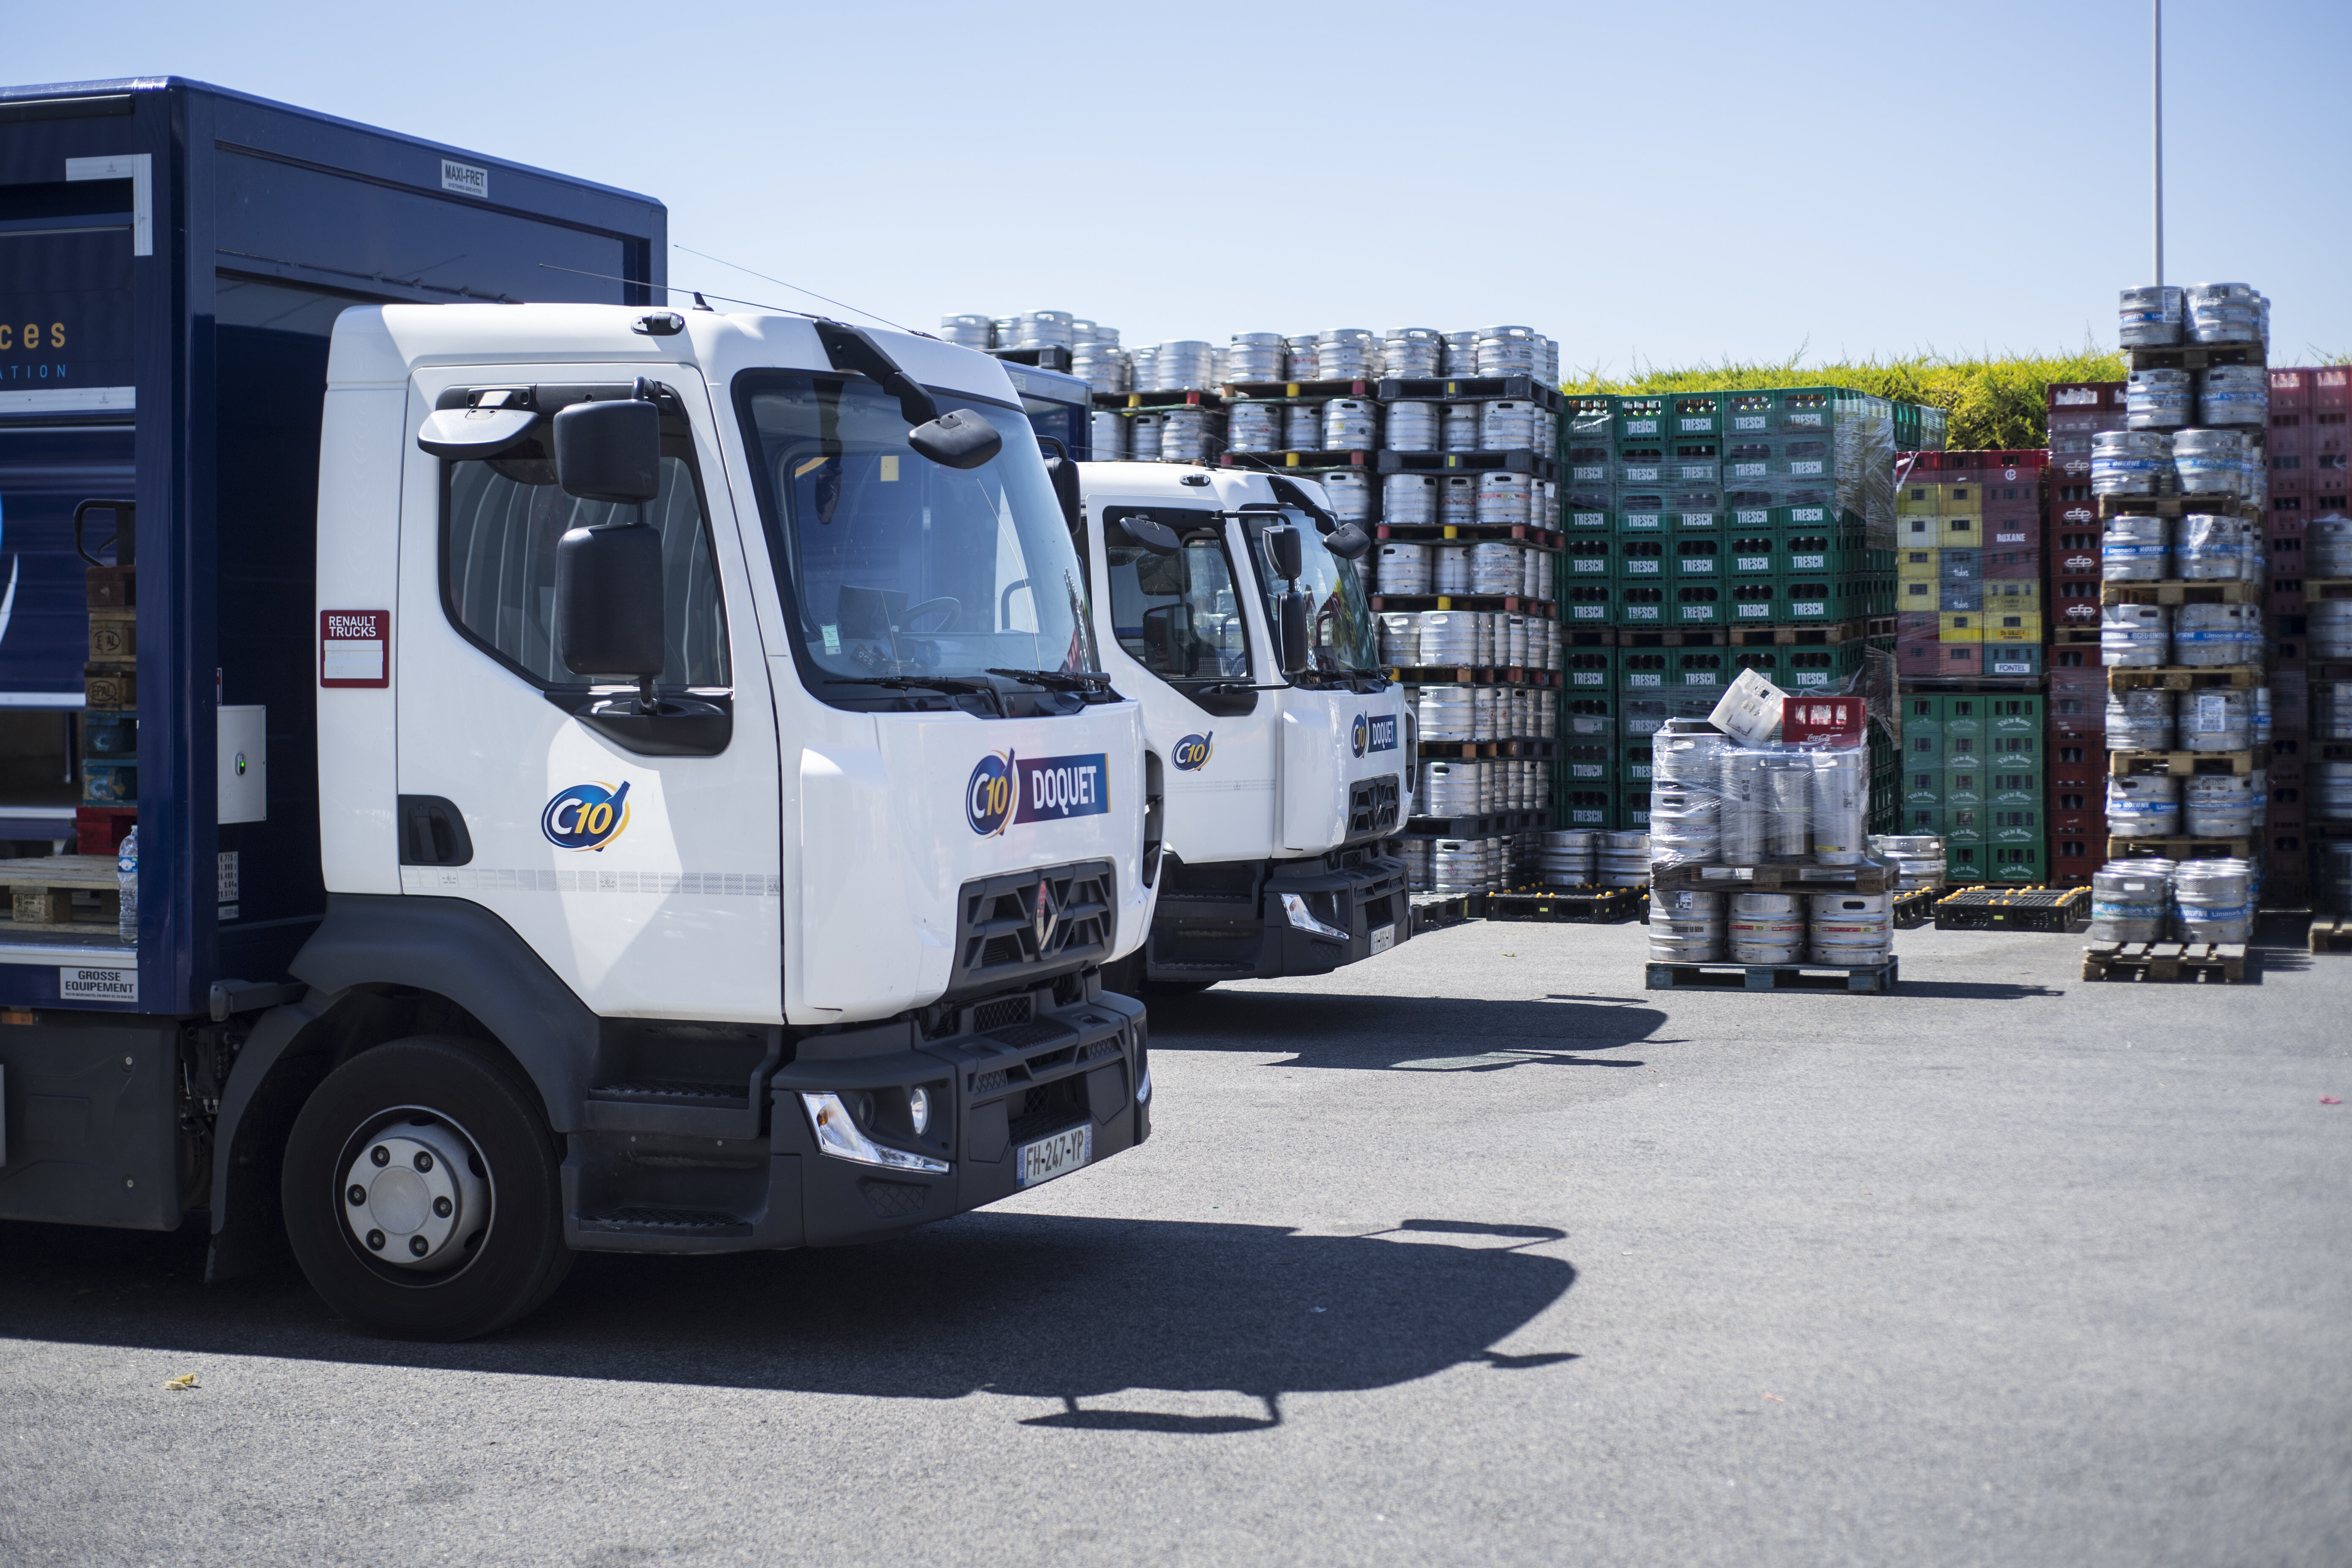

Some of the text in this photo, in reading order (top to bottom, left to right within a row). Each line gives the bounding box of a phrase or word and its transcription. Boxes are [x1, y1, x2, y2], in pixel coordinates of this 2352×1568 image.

[1681, 418, 1711, 430] TRESCH
[1735, 416, 1765, 429] TRESCH
[1735, 463, 1766, 476] TRESCH
[1791, 461, 1822, 474] TRESCH
[2066, 460, 2089, 471] cfp
[1573, 467, 1603, 479] TRESCH
[1627, 468, 1657, 480] TRESCH
[1574, 513, 1603, 525] TRESCH
[1682, 514, 1712, 525] TRESCH
[1737, 511, 1767, 523] TRESCH
[1792, 509, 1823, 521] TRESCH
[2065, 508, 2091, 519] cfp
[1628, 515, 1658, 527] TRESCH
[1996, 534, 2025, 542] ROXANE
[1574, 560, 1603, 572] TRESCH
[1628, 561, 1658, 573] TRESCH
[1682, 560, 1712, 572] TRESCH
[1738, 558, 1768, 570] TRESCH
[1793, 555, 1823, 568] TRESCH
[2067, 555, 2092, 567] cfp
[1574, 606, 1603, 618] TRESCH
[1628, 607, 1658, 618] TRESCH
[1682, 606, 1712, 618] TRESCH
[1793, 603, 1824, 615] TRESCH
[2069, 604, 2093, 616] cfp
[329, 616, 376, 626] RENAULT
[329, 627, 376, 637] TRUCKS
[1573, 673, 1603, 684] TRESCH
[1631, 675, 1661, 686] TRESCH
[1685, 673, 1715, 685] TRESCH
[1797, 673, 1827, 684] TRESCH
[1353, 721, 1394, 749] C10 DOQUET
[1176, 742, 1205, 764] C10
[972, 766, 1097, 819] C10 DOQUET
[552, 798, 612, 834] C10
[1573, 810, 1602, 822] TRESCH
[78, 971, 120, 981] GROSSE
[65, 981, 134, 993] EQUIPEMENT
[1026, 1130, 1083, 1179] FH-247-YP
